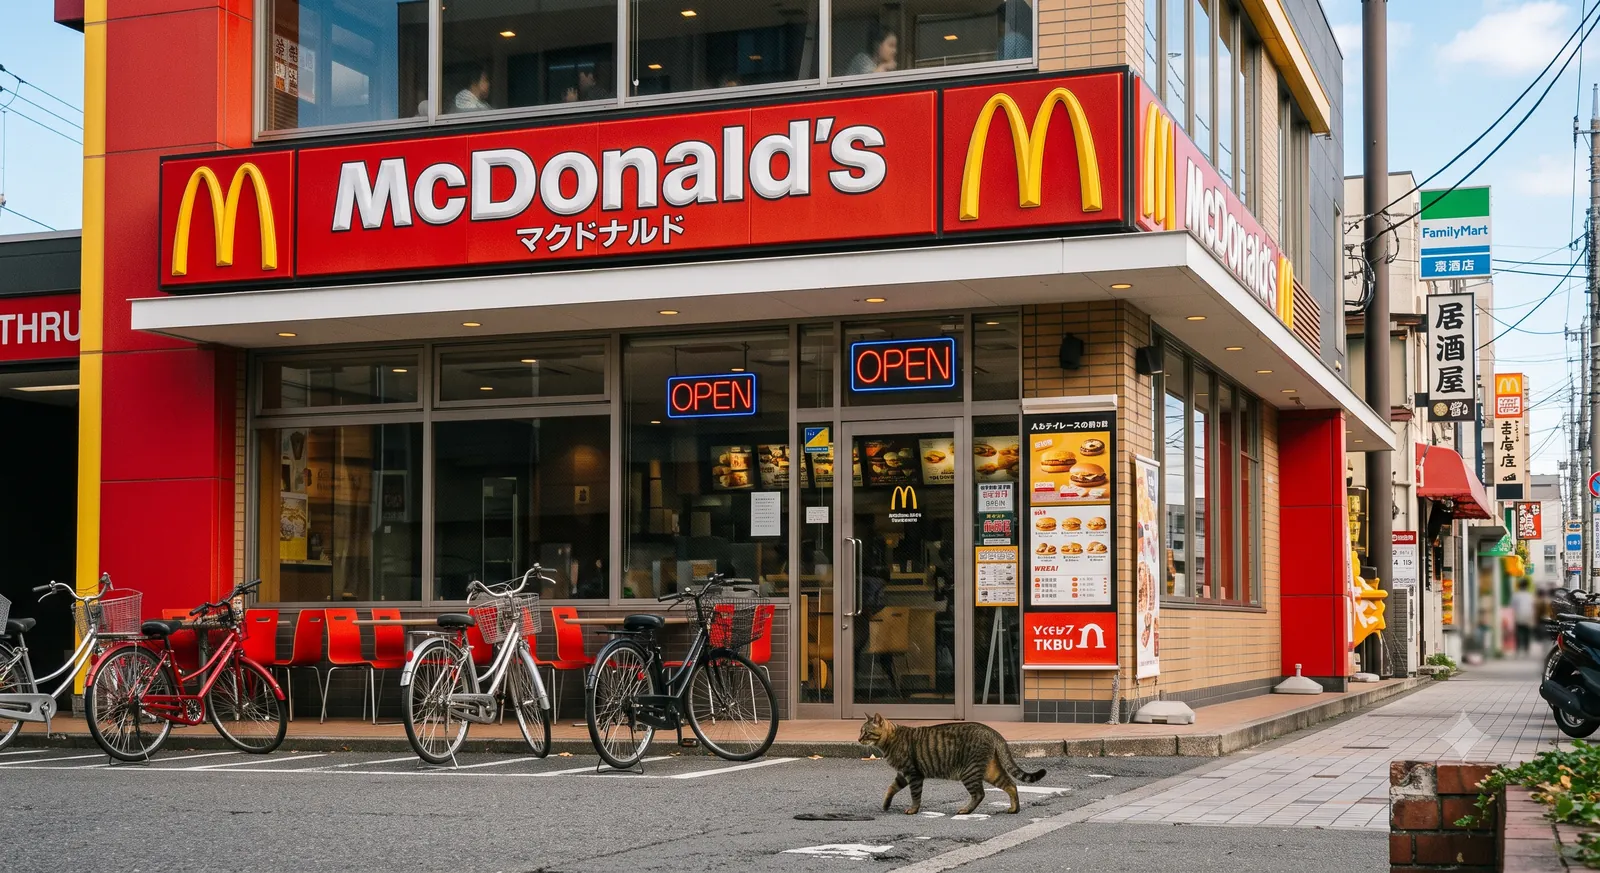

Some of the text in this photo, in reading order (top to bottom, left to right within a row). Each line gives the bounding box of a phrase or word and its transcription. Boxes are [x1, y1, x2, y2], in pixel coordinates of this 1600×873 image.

[331, 116, 887, 232] McDonald's
[516, 214, 685, 253] マクドナルド
[1184, 156, 1277, 310] McDonald's
[1421, 224, 1489, 241] FamilyMart
[0, 309, 82, 345] THRU
[856, 346, 949, 384] OPEN
[1435, 301, 1467, 394] 居酒屋
[671, 378, 751, 412] OPEN
[1033, 638, 1074, 651] TKBU
